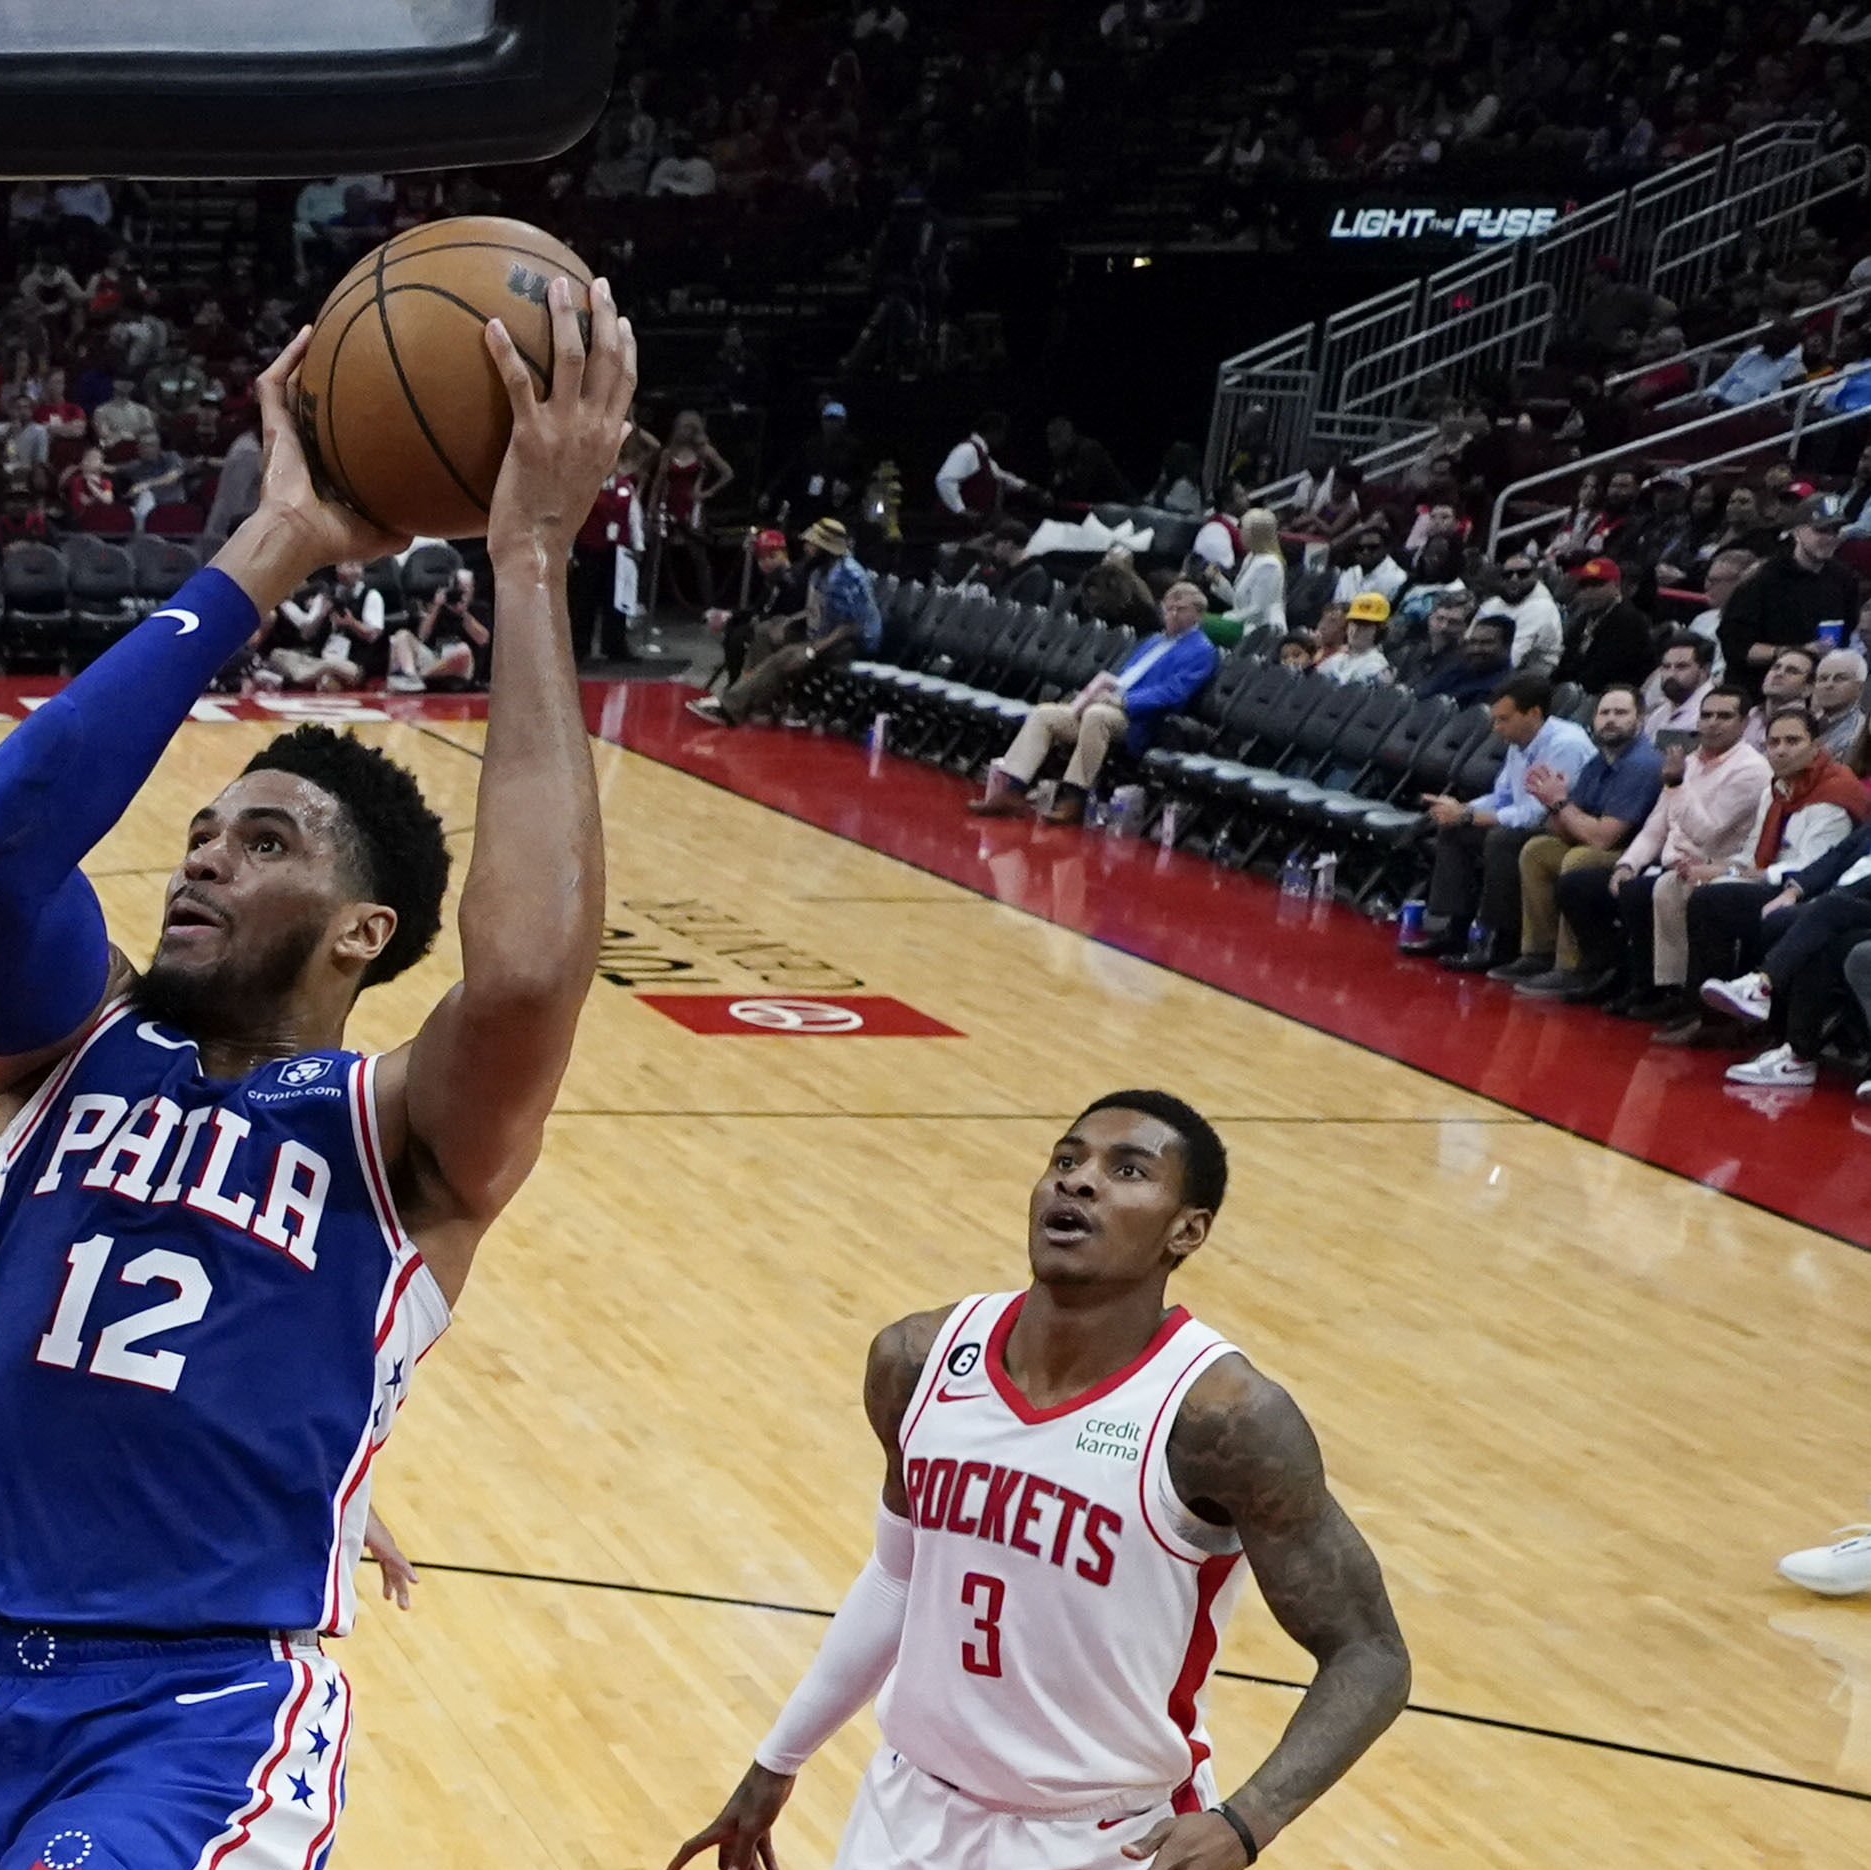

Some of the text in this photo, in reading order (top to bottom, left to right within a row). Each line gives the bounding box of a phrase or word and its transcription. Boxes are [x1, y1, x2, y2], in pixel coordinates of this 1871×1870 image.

[1329, 208, 1437, 238] LIGHT
[1453, 208, 1557, 238] FUSE
[247, 1086, 342, 1104] crypto.com
[33, 1092, 332, 1272] PHILA
[36, 1233, 214, 1393] 12
[957, 1347, 978, 1373] 6
[1085, 1418, 1142, 1442] credit
[1075, 1436, 1139, 1462] karma
[909, 1457, 1124, 1588] ROCKETS
[961, 1571, 1006, 1679] 3
